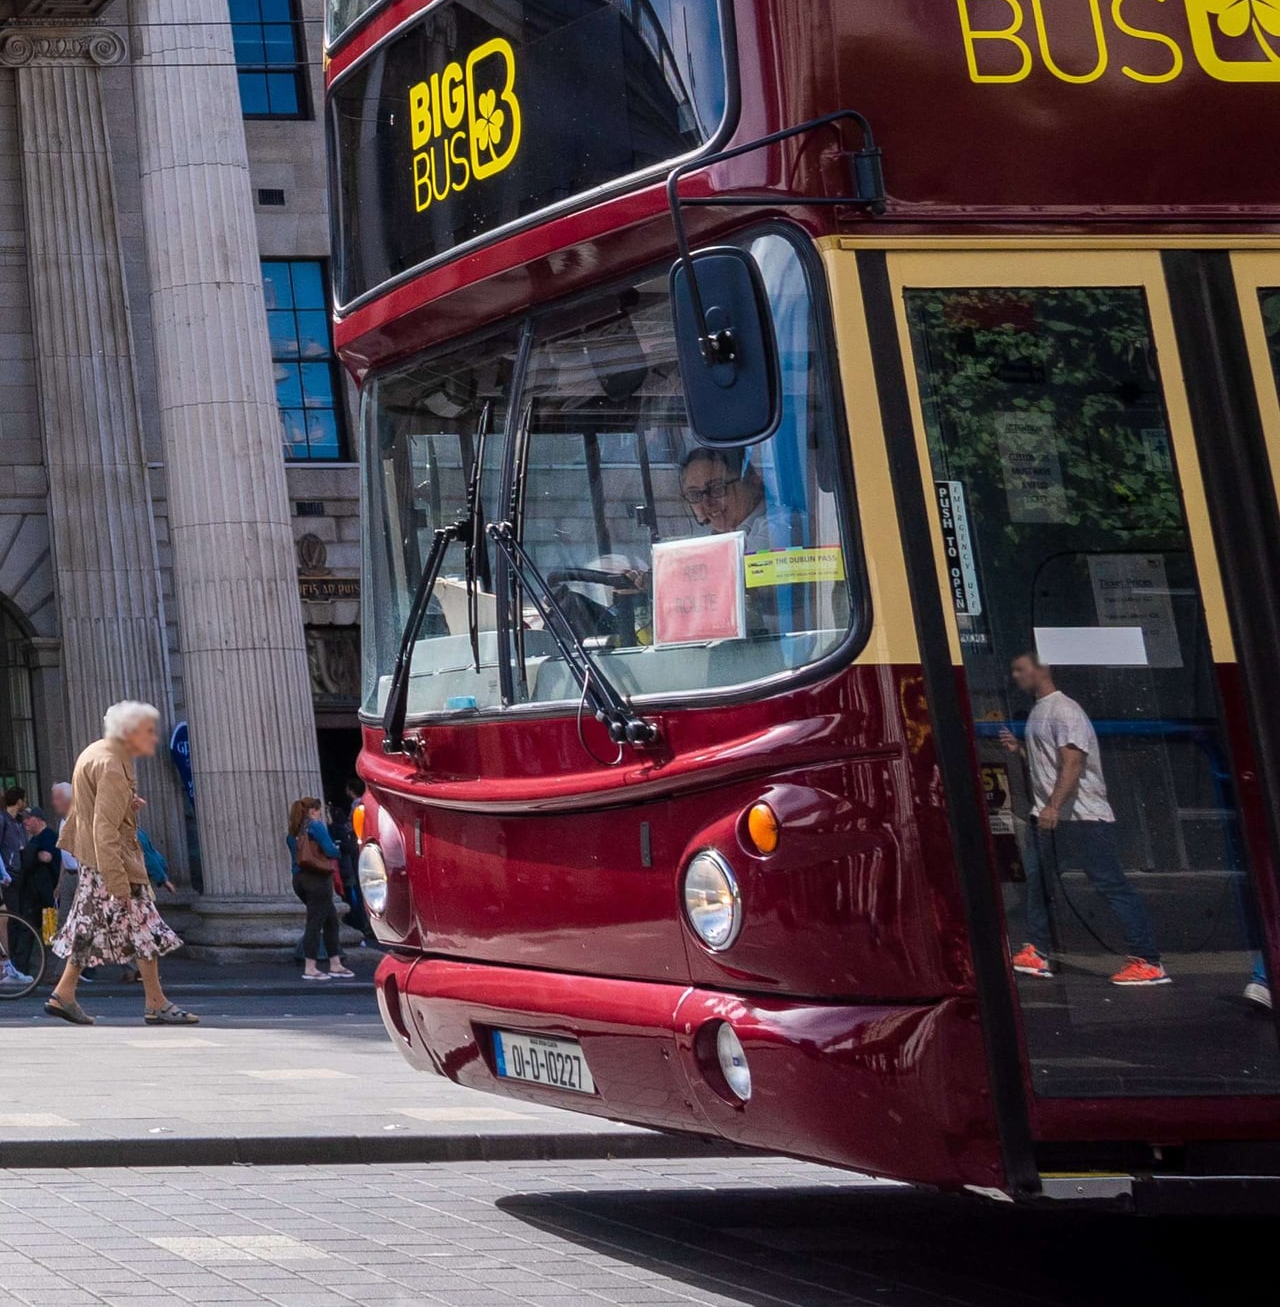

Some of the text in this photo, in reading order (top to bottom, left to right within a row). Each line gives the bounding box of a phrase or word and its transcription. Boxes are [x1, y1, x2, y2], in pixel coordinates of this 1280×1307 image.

[409, 62, 465, 150] BIG
[413, 131, 470, 213] BUS
[775, 556, 788, 565] THE
[790, 555, 816, 564] DUBLIN
[817, 554, 838, 562] PASS
[939, 487, 965, 609] PUSH TO OPEN
[953, 486, 976, 609] EMERGENCY USE
[511, 1044, 582, 1089] 01-D-10227
